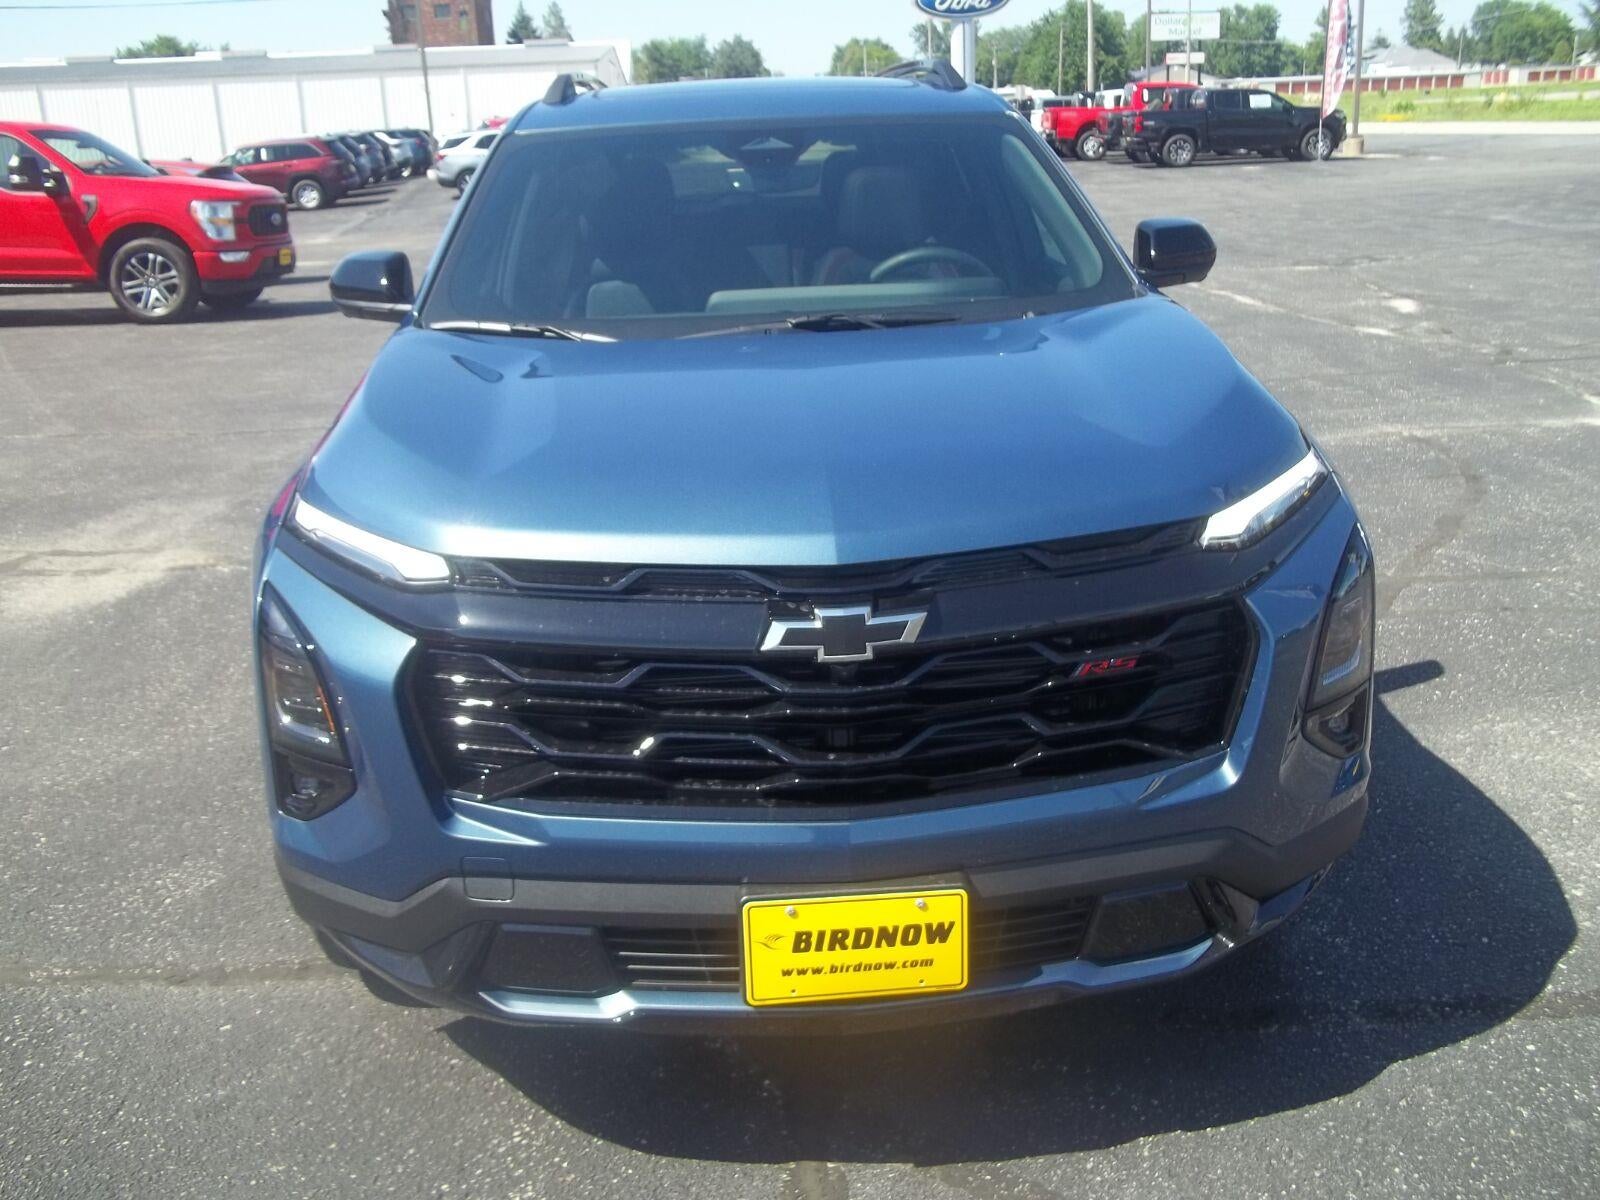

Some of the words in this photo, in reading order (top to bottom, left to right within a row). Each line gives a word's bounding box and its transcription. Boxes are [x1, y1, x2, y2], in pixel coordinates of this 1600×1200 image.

[1168, 27, 1202, 36] Maret
[1075, 657, 1138, 678] RS
[791, 920, 956, 954] BIRDNOW
[781, 957, 935, 977] www.birdnow.com
